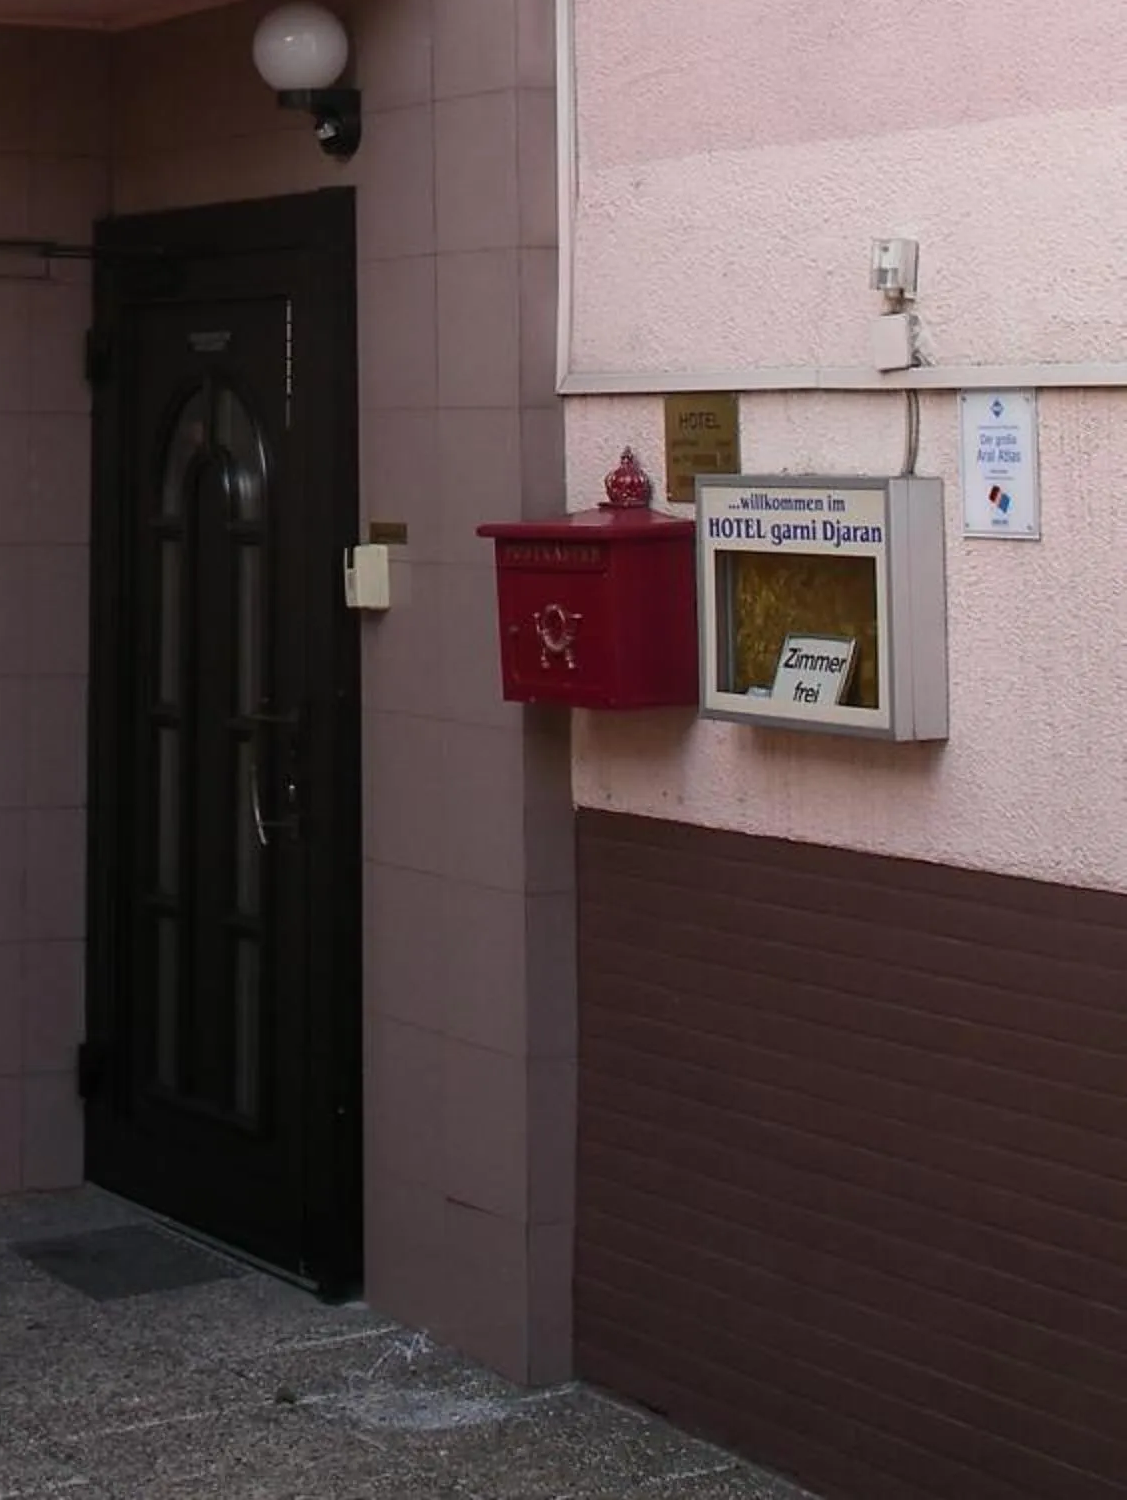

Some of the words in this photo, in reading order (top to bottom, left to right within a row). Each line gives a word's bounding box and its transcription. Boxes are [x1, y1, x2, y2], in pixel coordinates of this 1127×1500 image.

[678, 410, 722, 431] HOTEL
[827, 494, 846, 512] im
[708, 517, 766, 539] HOTEL
[770, 519, 816, 546] garni
[822, 518, 883, 548] Djaran
[783, 647, 848, 674] Zimmer
[793, 680, 822, 704] frei
